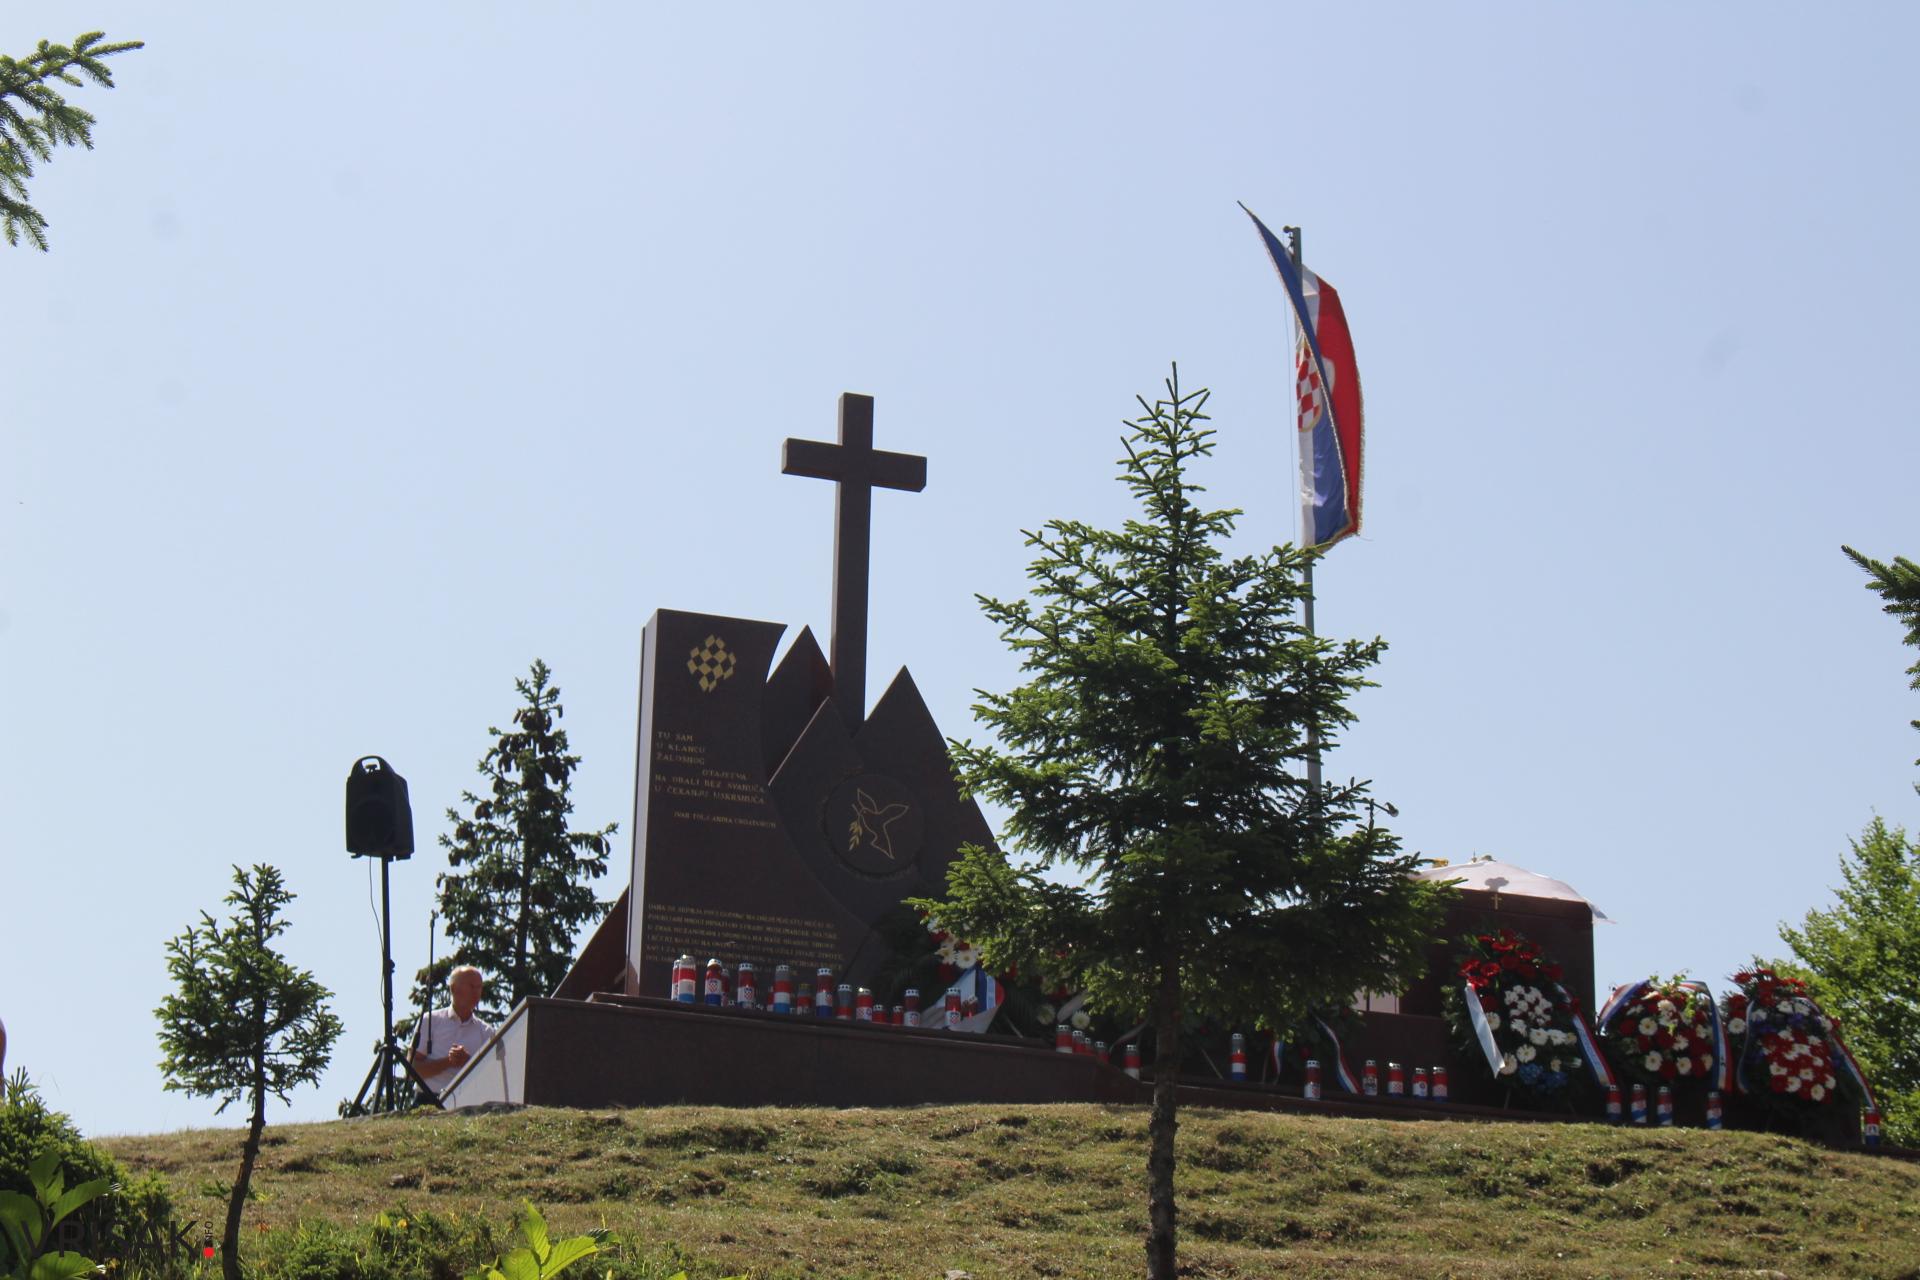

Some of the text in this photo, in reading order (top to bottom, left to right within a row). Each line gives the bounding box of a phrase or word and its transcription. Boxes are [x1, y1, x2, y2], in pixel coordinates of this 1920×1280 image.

[657, 731, 693, 742] TU SAM
[704, 779, 721, 788] BEZ
